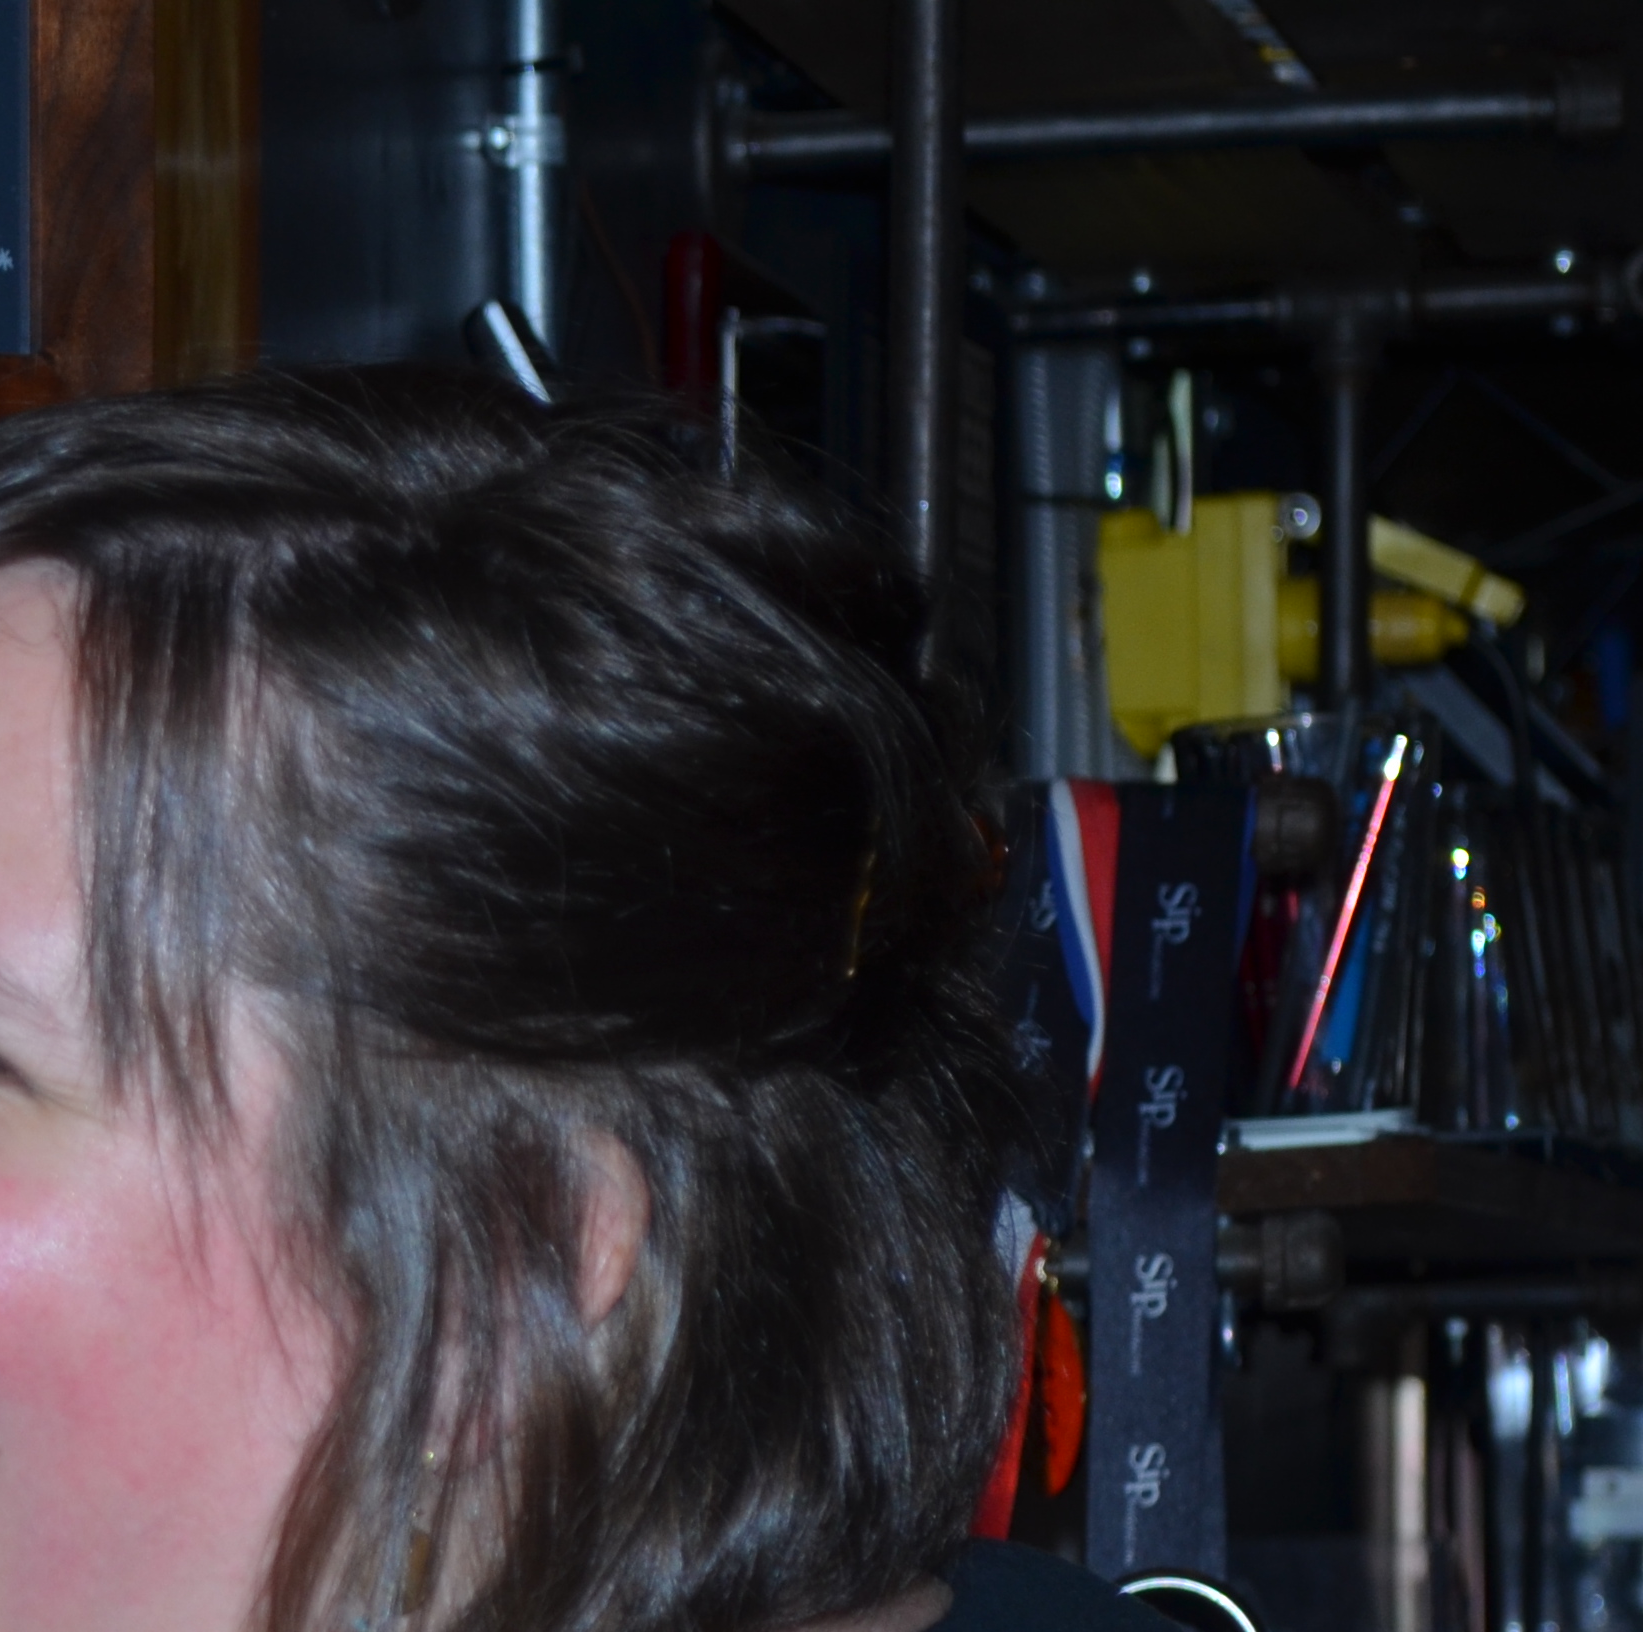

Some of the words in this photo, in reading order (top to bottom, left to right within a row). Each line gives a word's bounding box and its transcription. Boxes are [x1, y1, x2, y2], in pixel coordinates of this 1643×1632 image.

[1151, 882, 1202, 944] Sip
[1138, 1063, 1185, 1129] Sip
[1130, 1252, 1178, 1319] Sip
[1124, 1442, 1170, 1508] Sip
